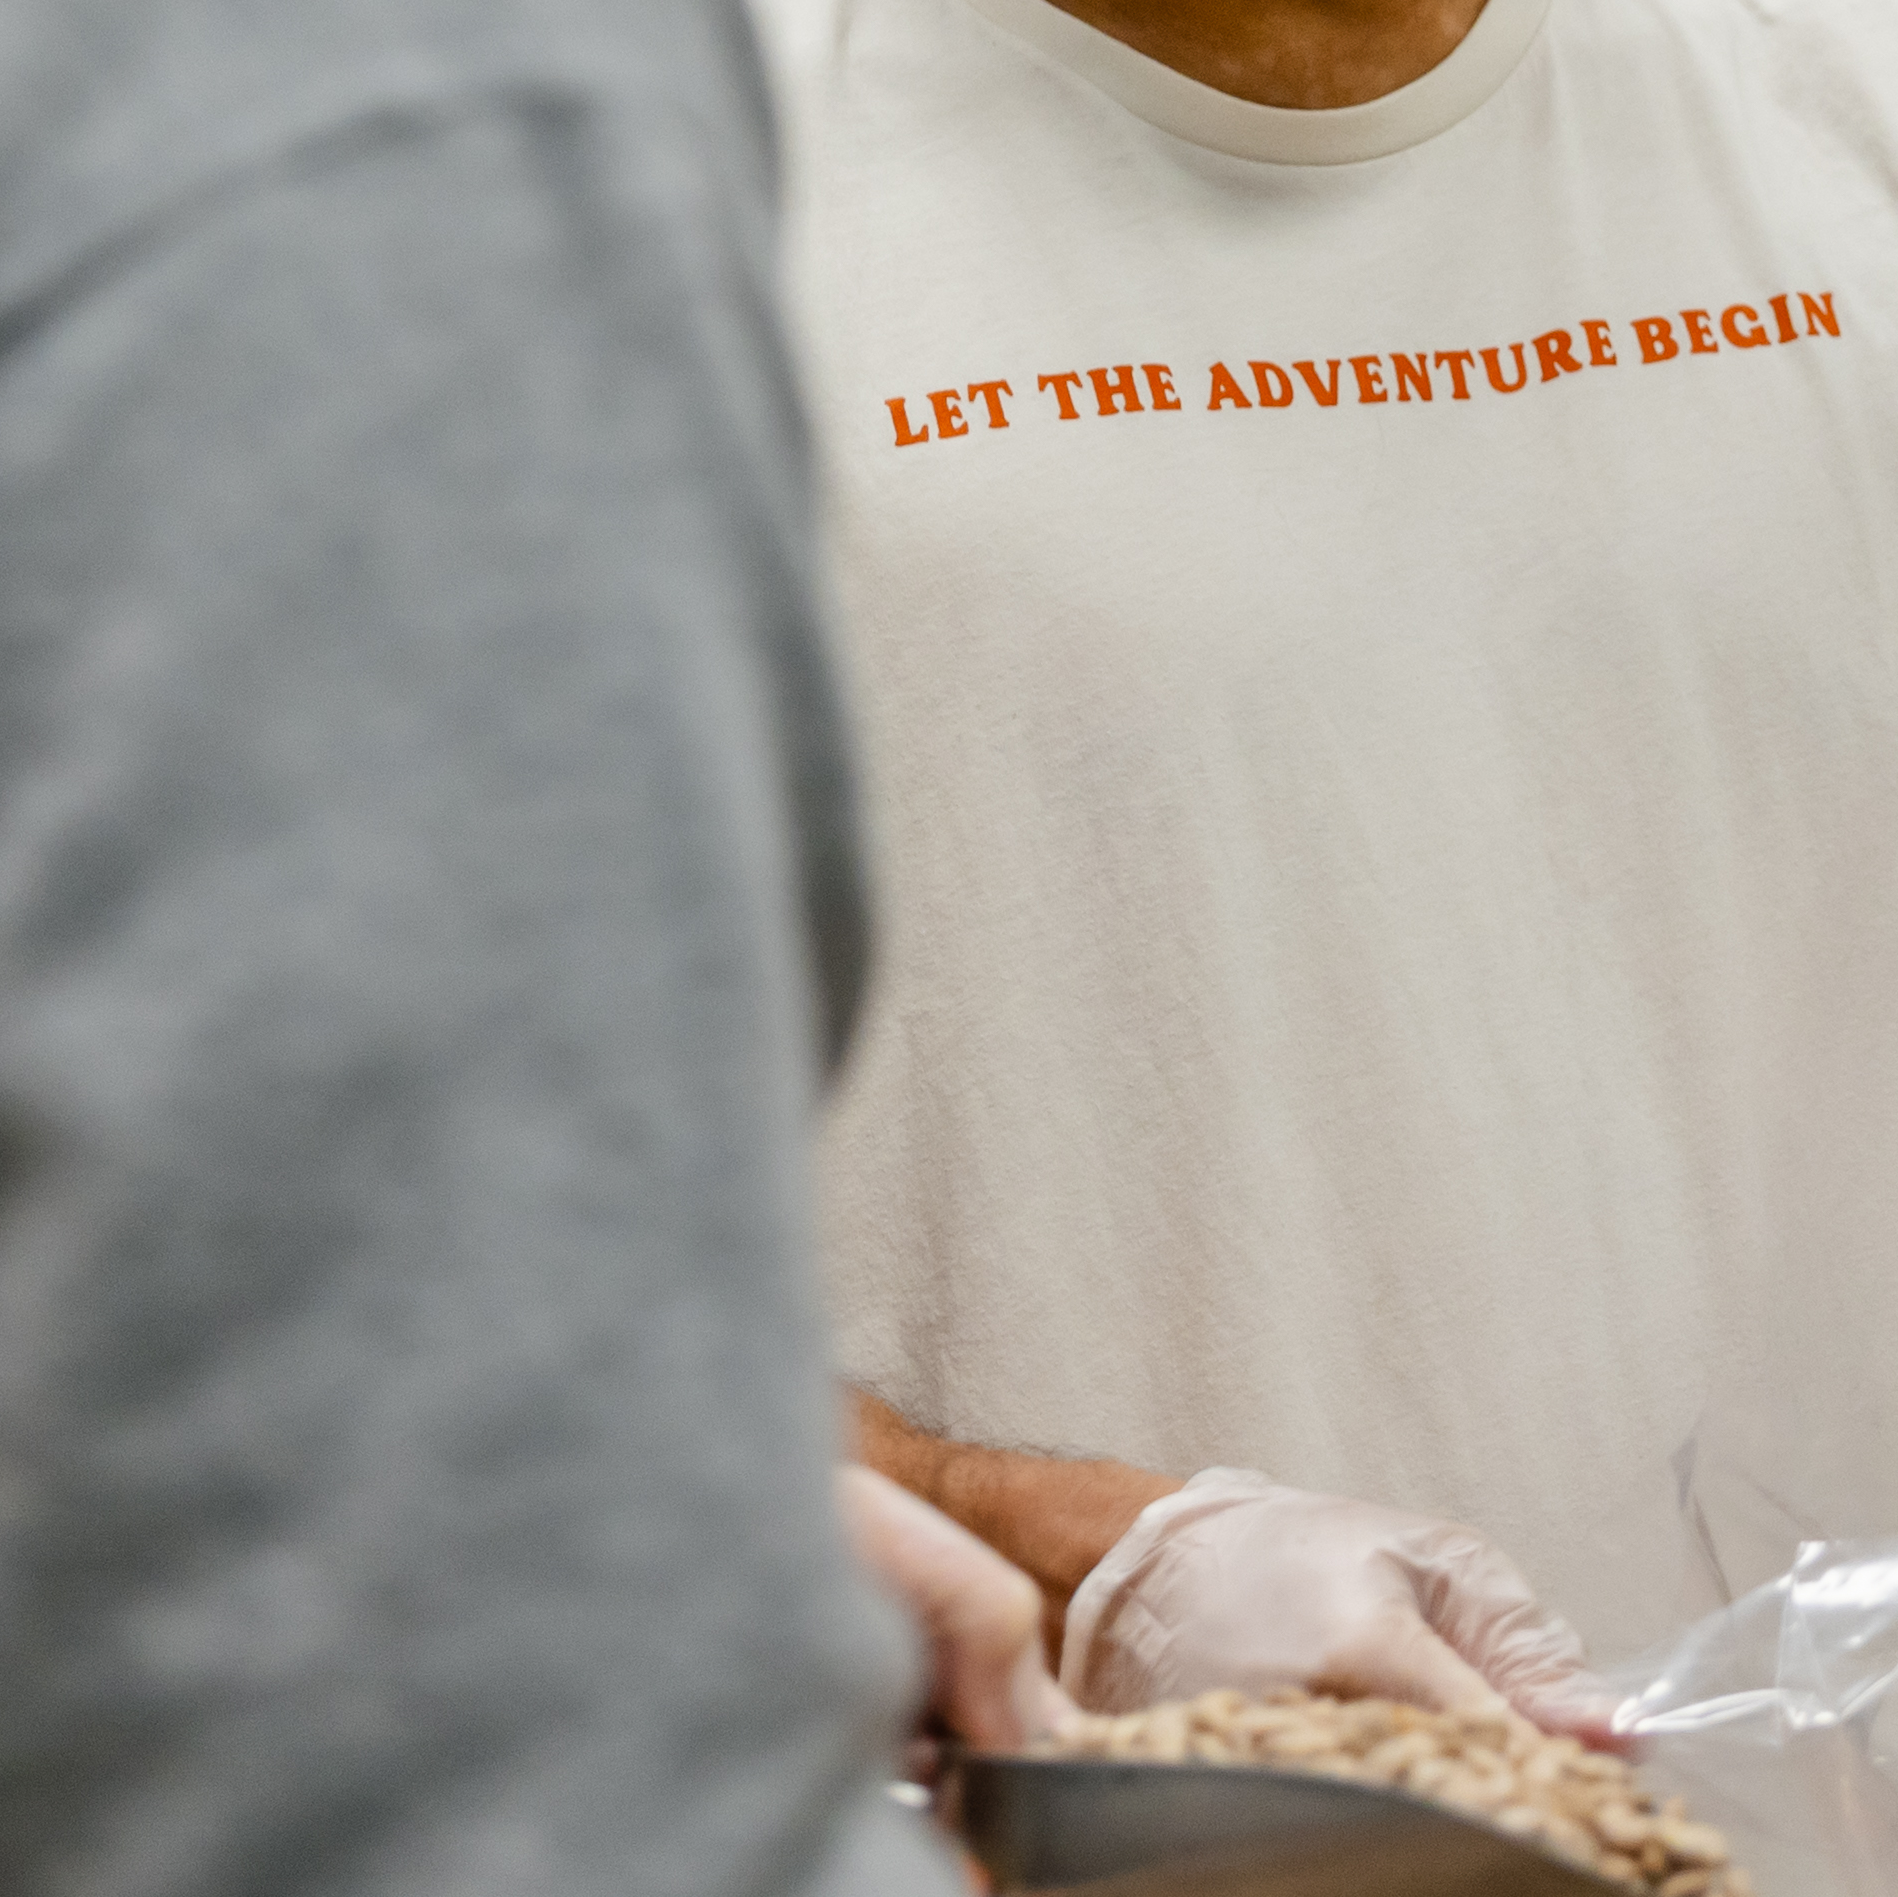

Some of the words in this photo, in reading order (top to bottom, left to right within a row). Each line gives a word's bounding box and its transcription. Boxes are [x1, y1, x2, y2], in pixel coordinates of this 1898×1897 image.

[885, 379, 1013, 447] LET
[1037, 363, 1182, 421] THE
[1207, 319, 1618, 411] ADVENTURE
[1631, 292, 1841, 365] BEGIN
